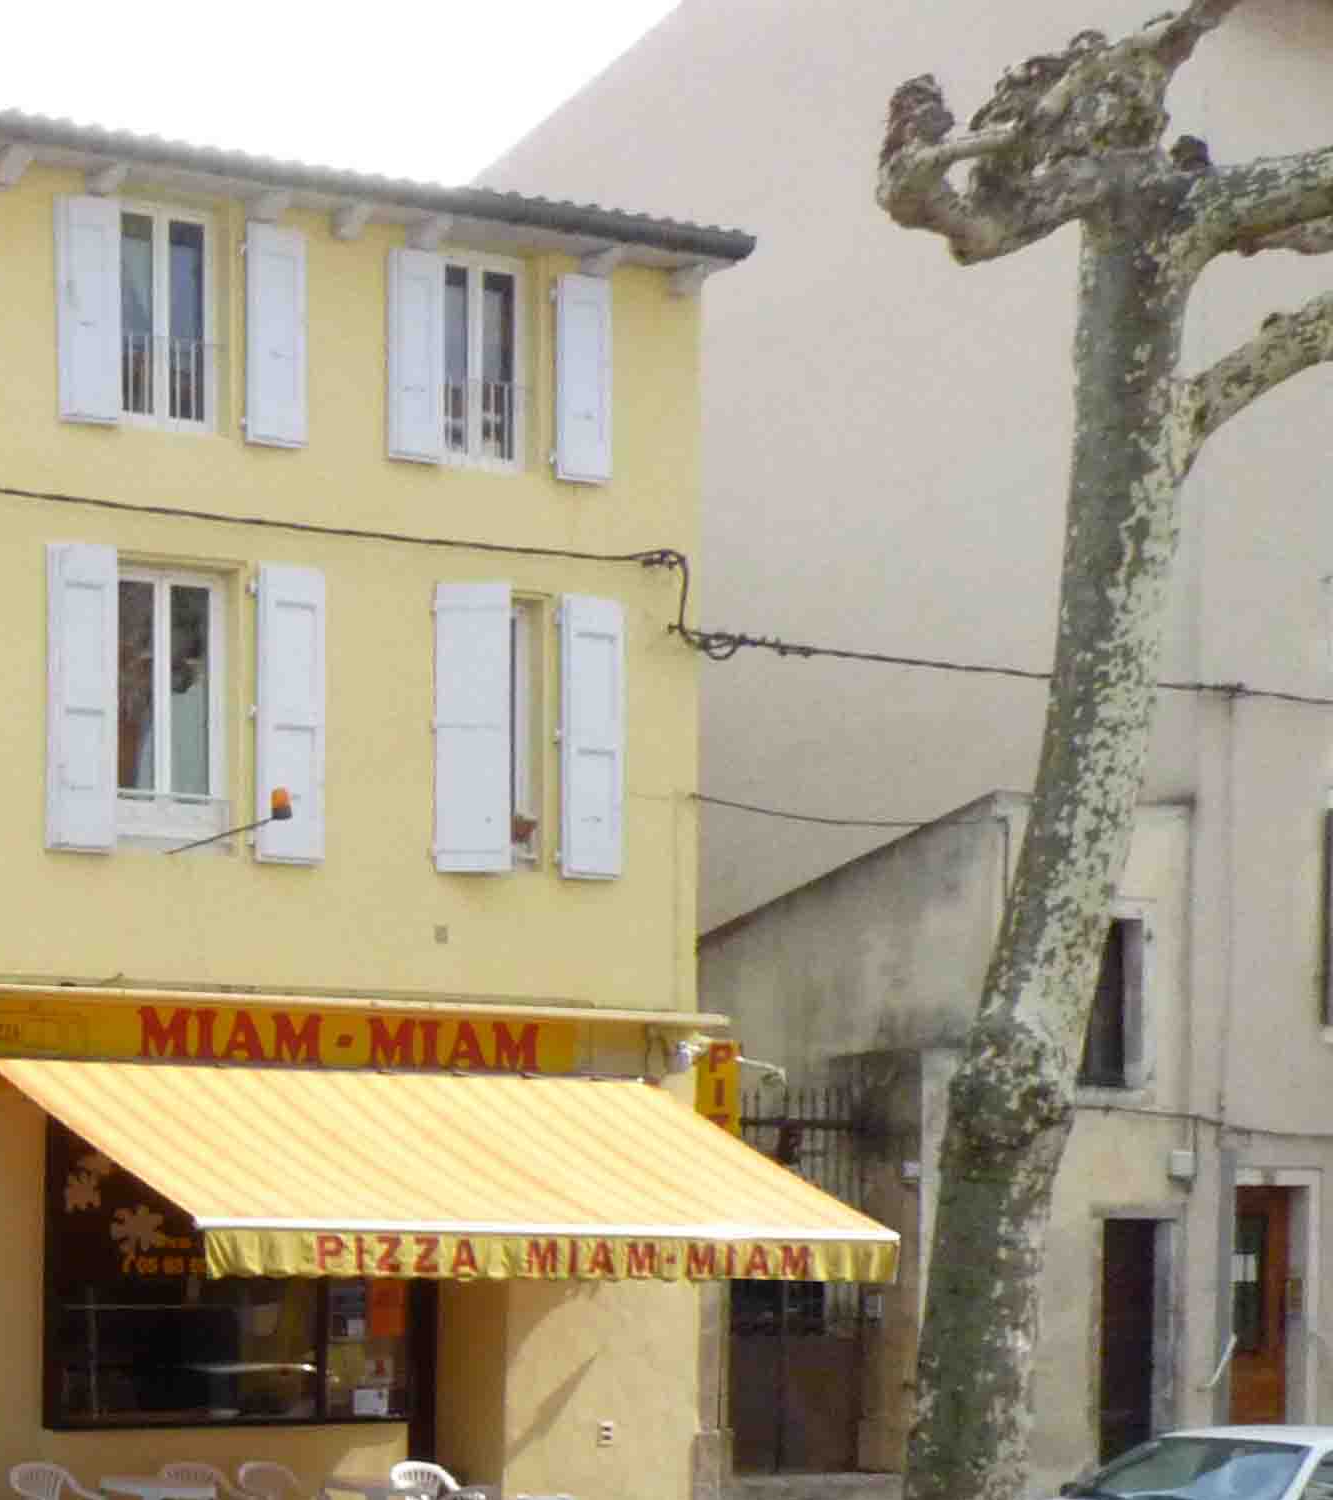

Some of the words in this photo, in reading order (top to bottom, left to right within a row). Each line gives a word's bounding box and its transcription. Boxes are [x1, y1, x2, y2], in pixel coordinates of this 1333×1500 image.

[137, 1006, 323, 1067] MIAM
[367, 1017, 540, 1074] MIAM
[316, 1234, 478, 1273] PIZZA
